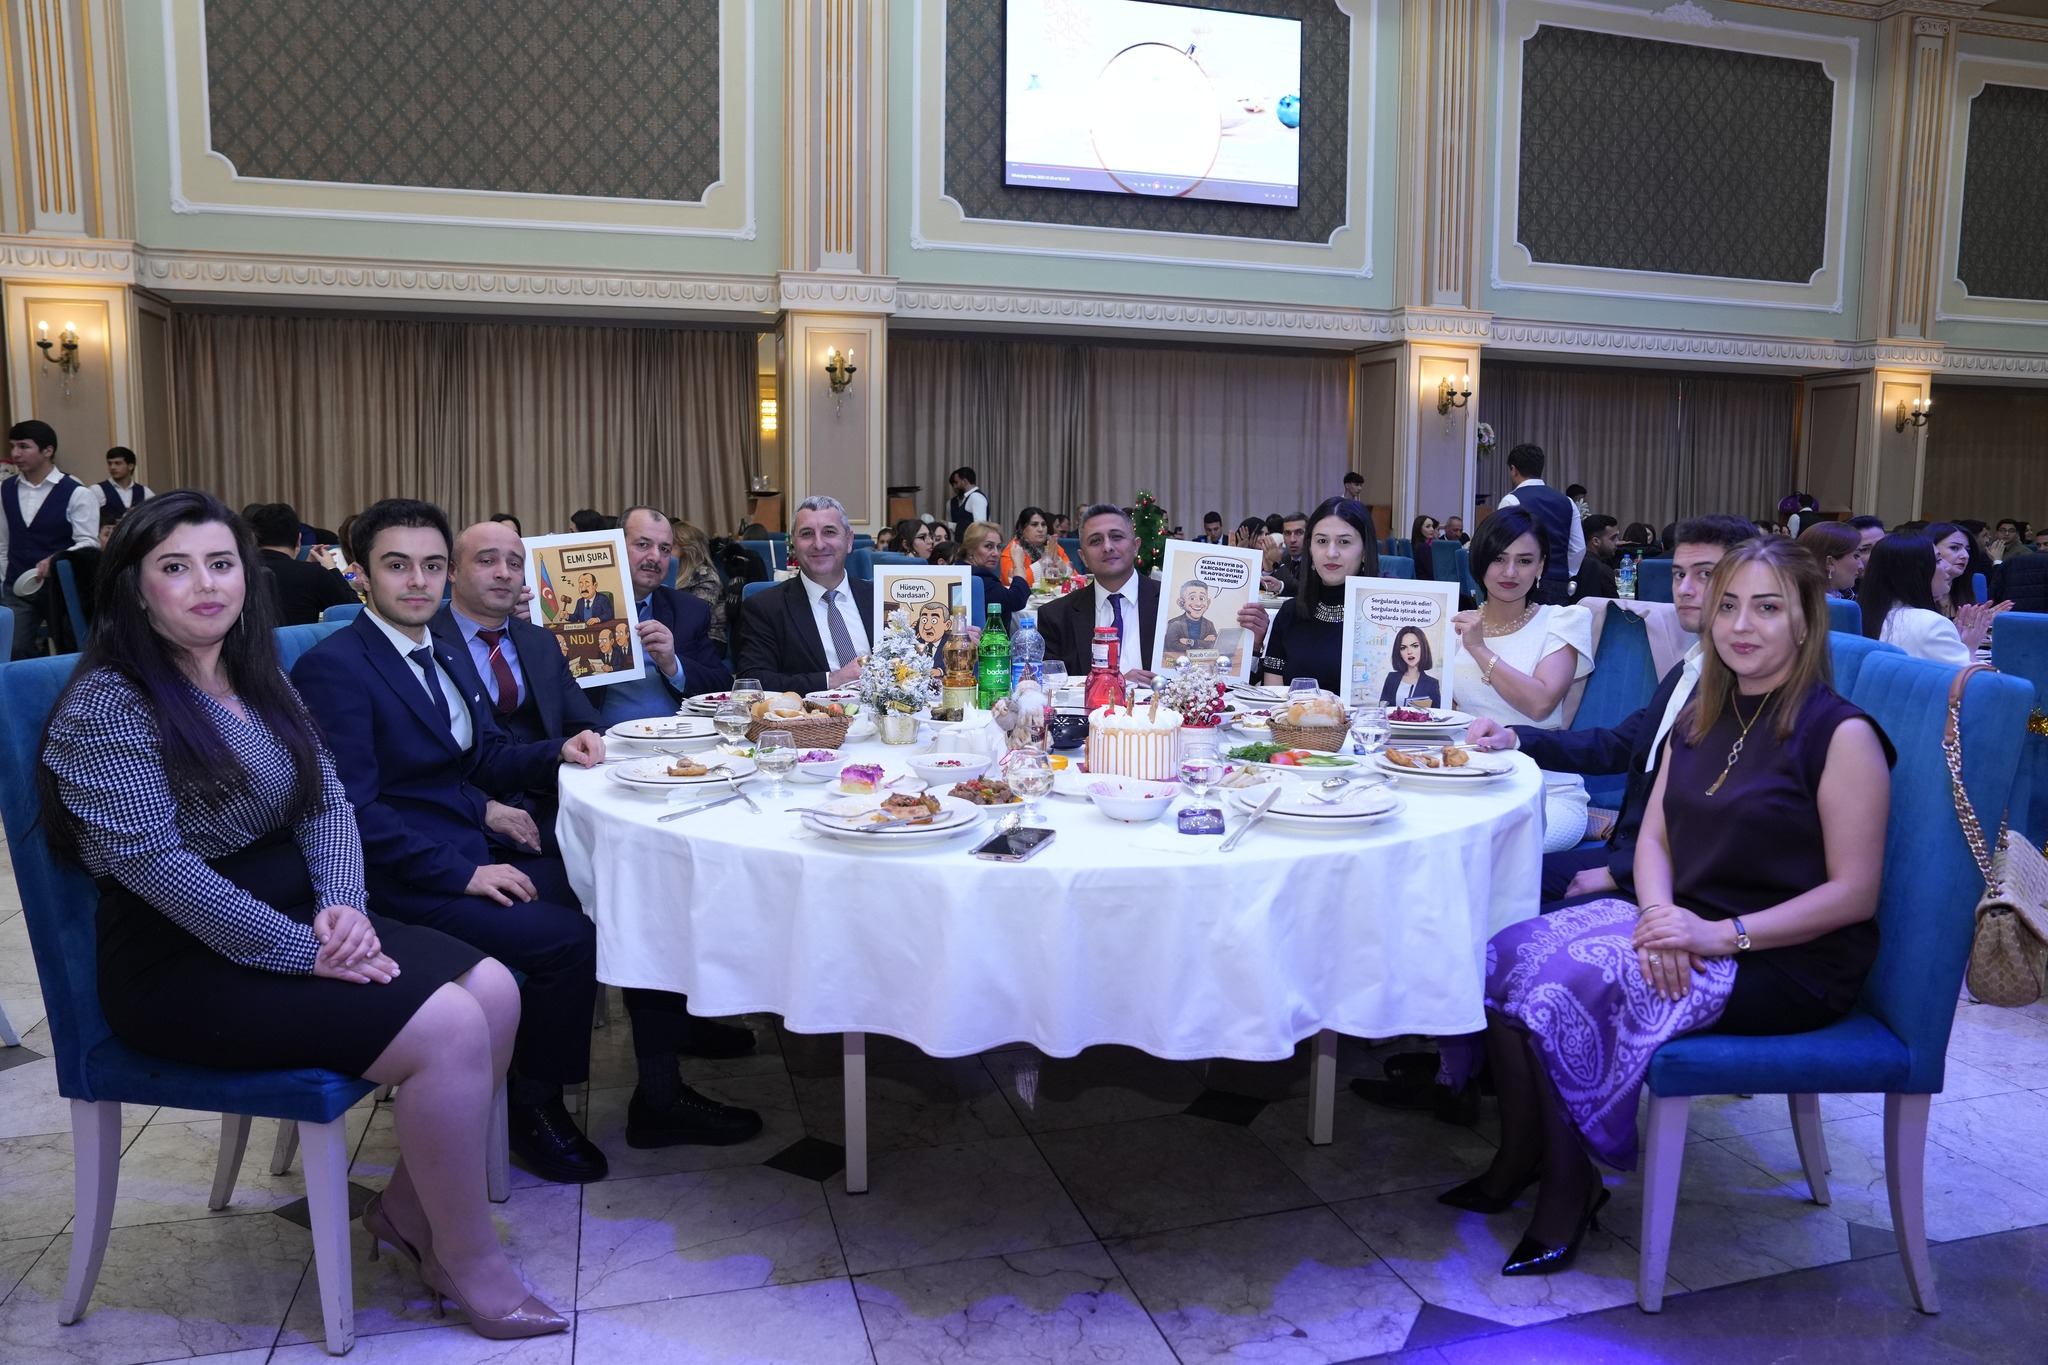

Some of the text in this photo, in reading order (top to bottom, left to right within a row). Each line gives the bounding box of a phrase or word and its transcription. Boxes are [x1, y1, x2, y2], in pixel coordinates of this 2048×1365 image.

[566, 552, 609, 564] ELMİ ŞURA
[896, 591, 930, 599] hardasan?
[1371, 597, 1400, 605] Sorğularda
[1371, 605, 1399, 613] Sorğularda
[1370, 613, 1399, 621] Sorğularda
[569, 634, 595, 645] NDU
